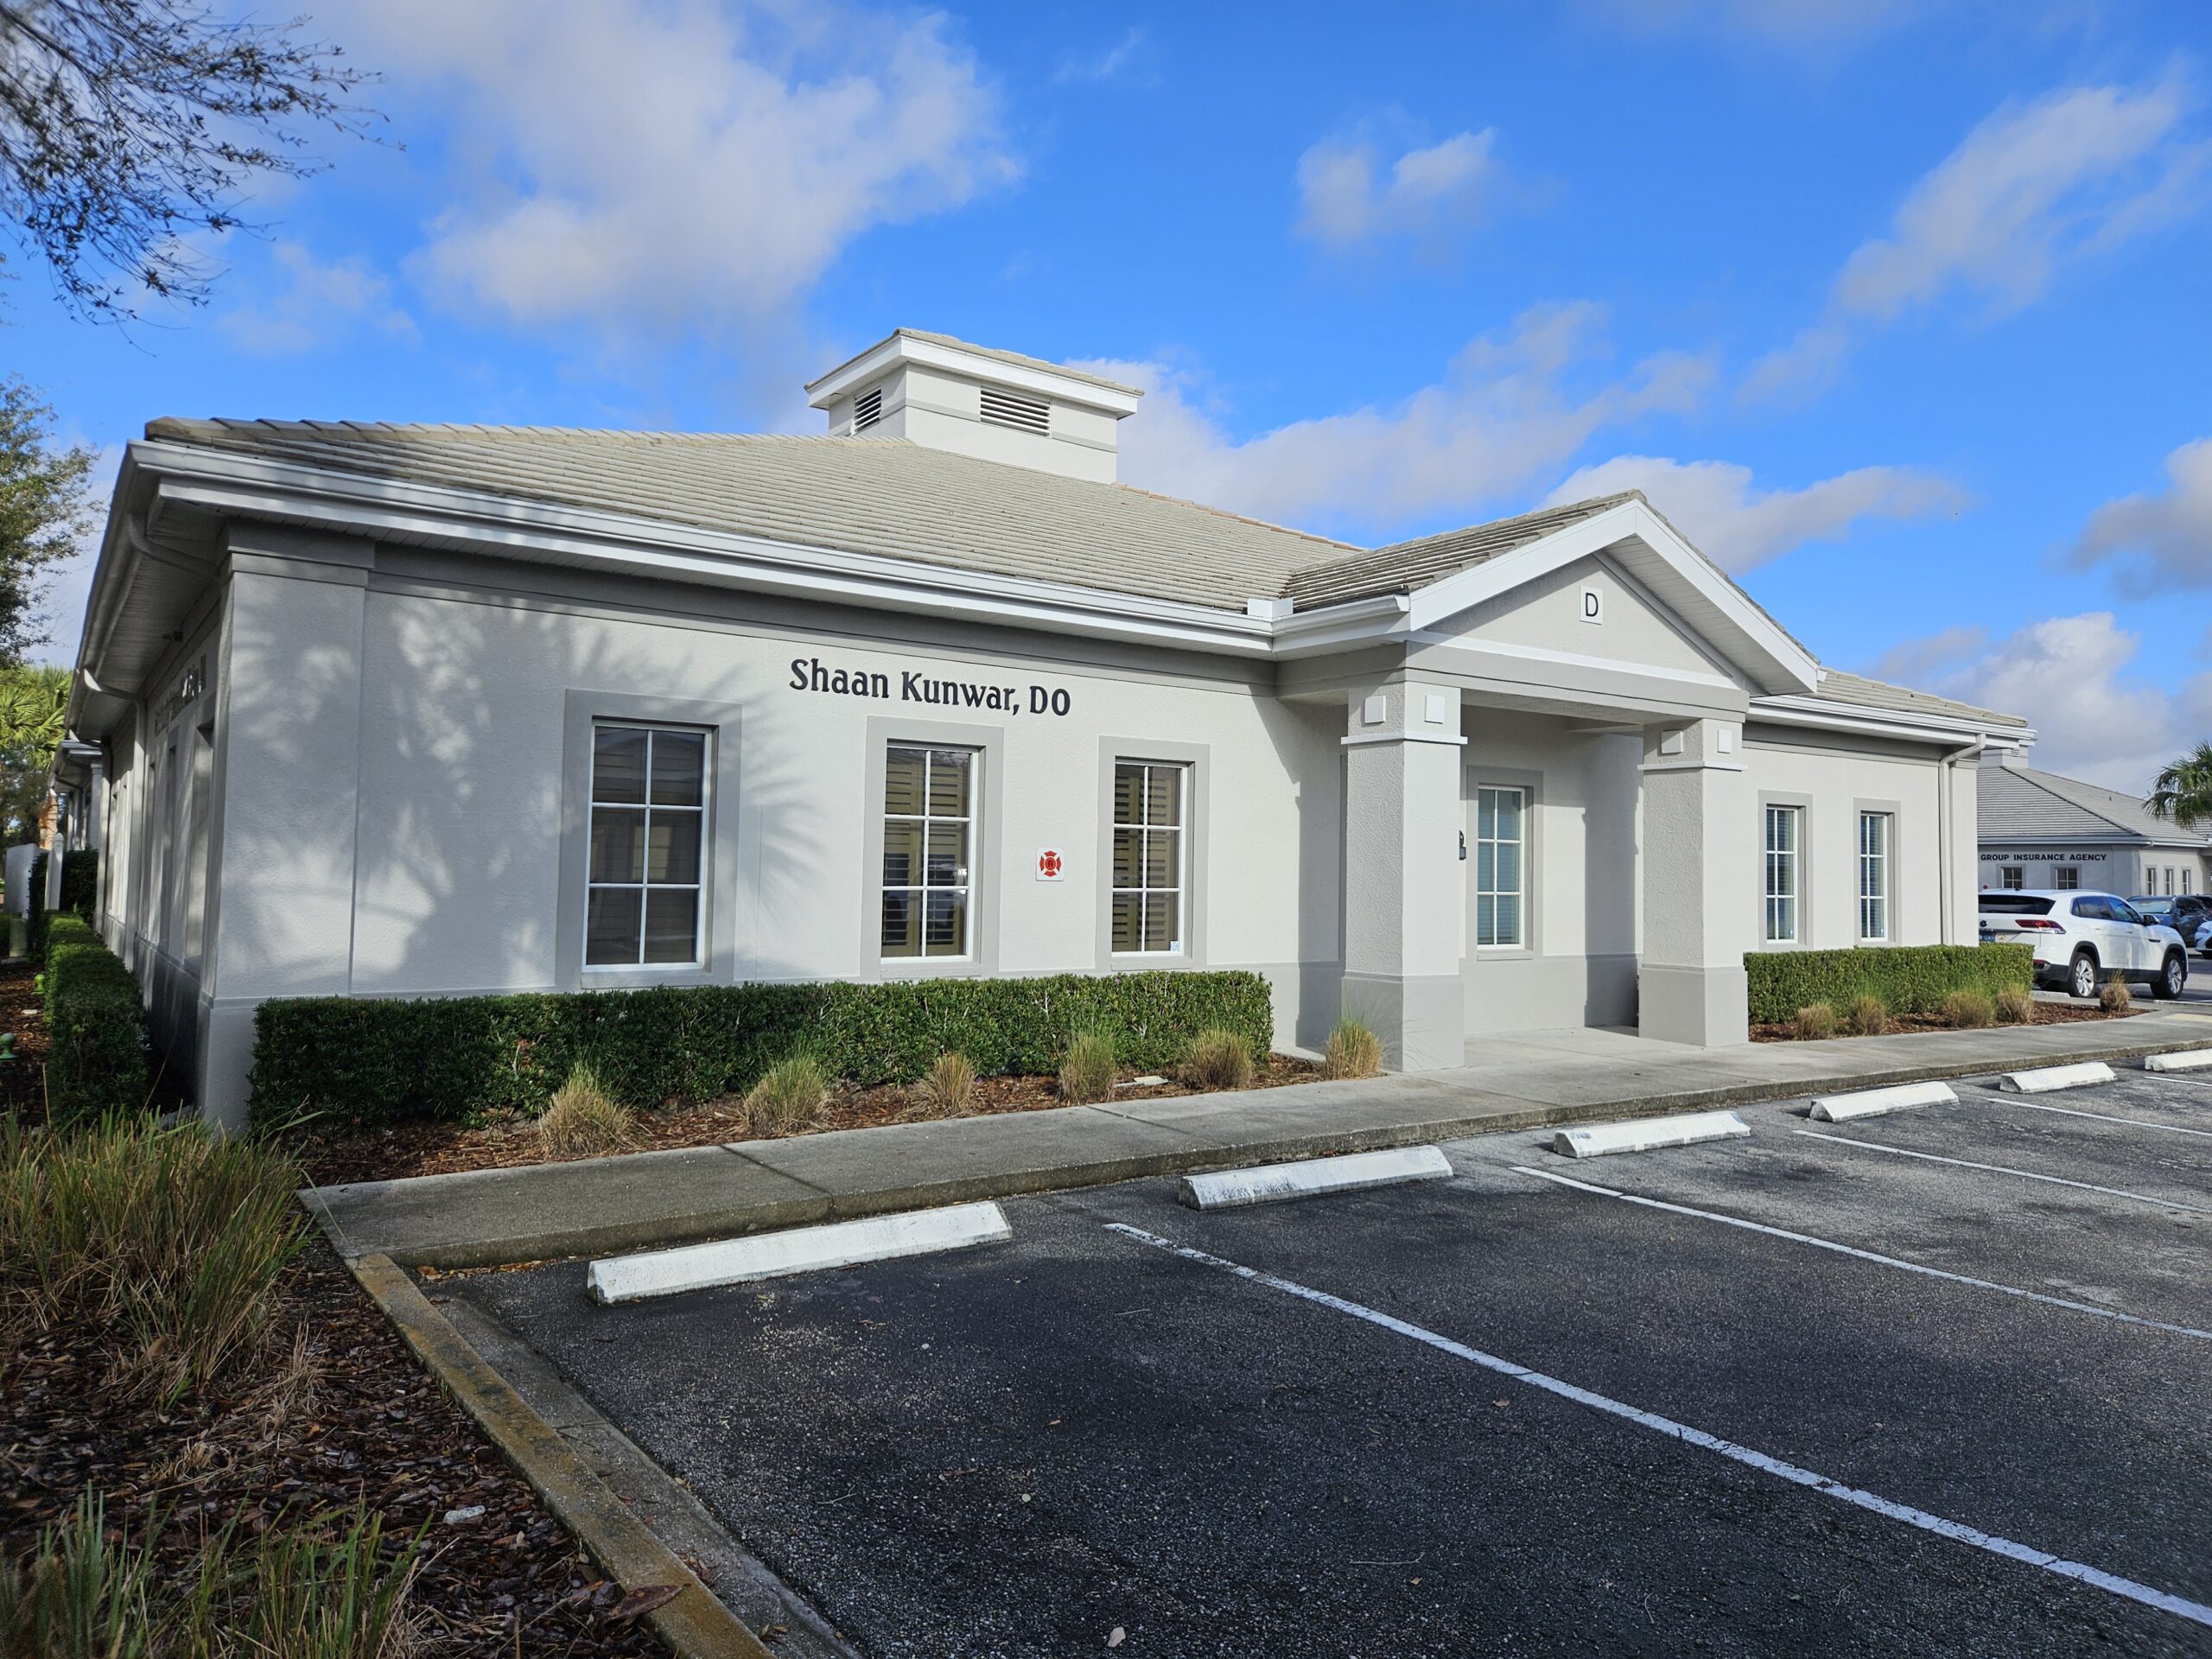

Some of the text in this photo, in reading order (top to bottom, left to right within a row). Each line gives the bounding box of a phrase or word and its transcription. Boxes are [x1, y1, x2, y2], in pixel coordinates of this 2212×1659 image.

[1585, 592, 1599, 618] D
[789, 658, 1071, 717] Shaan Kunwar, DO
